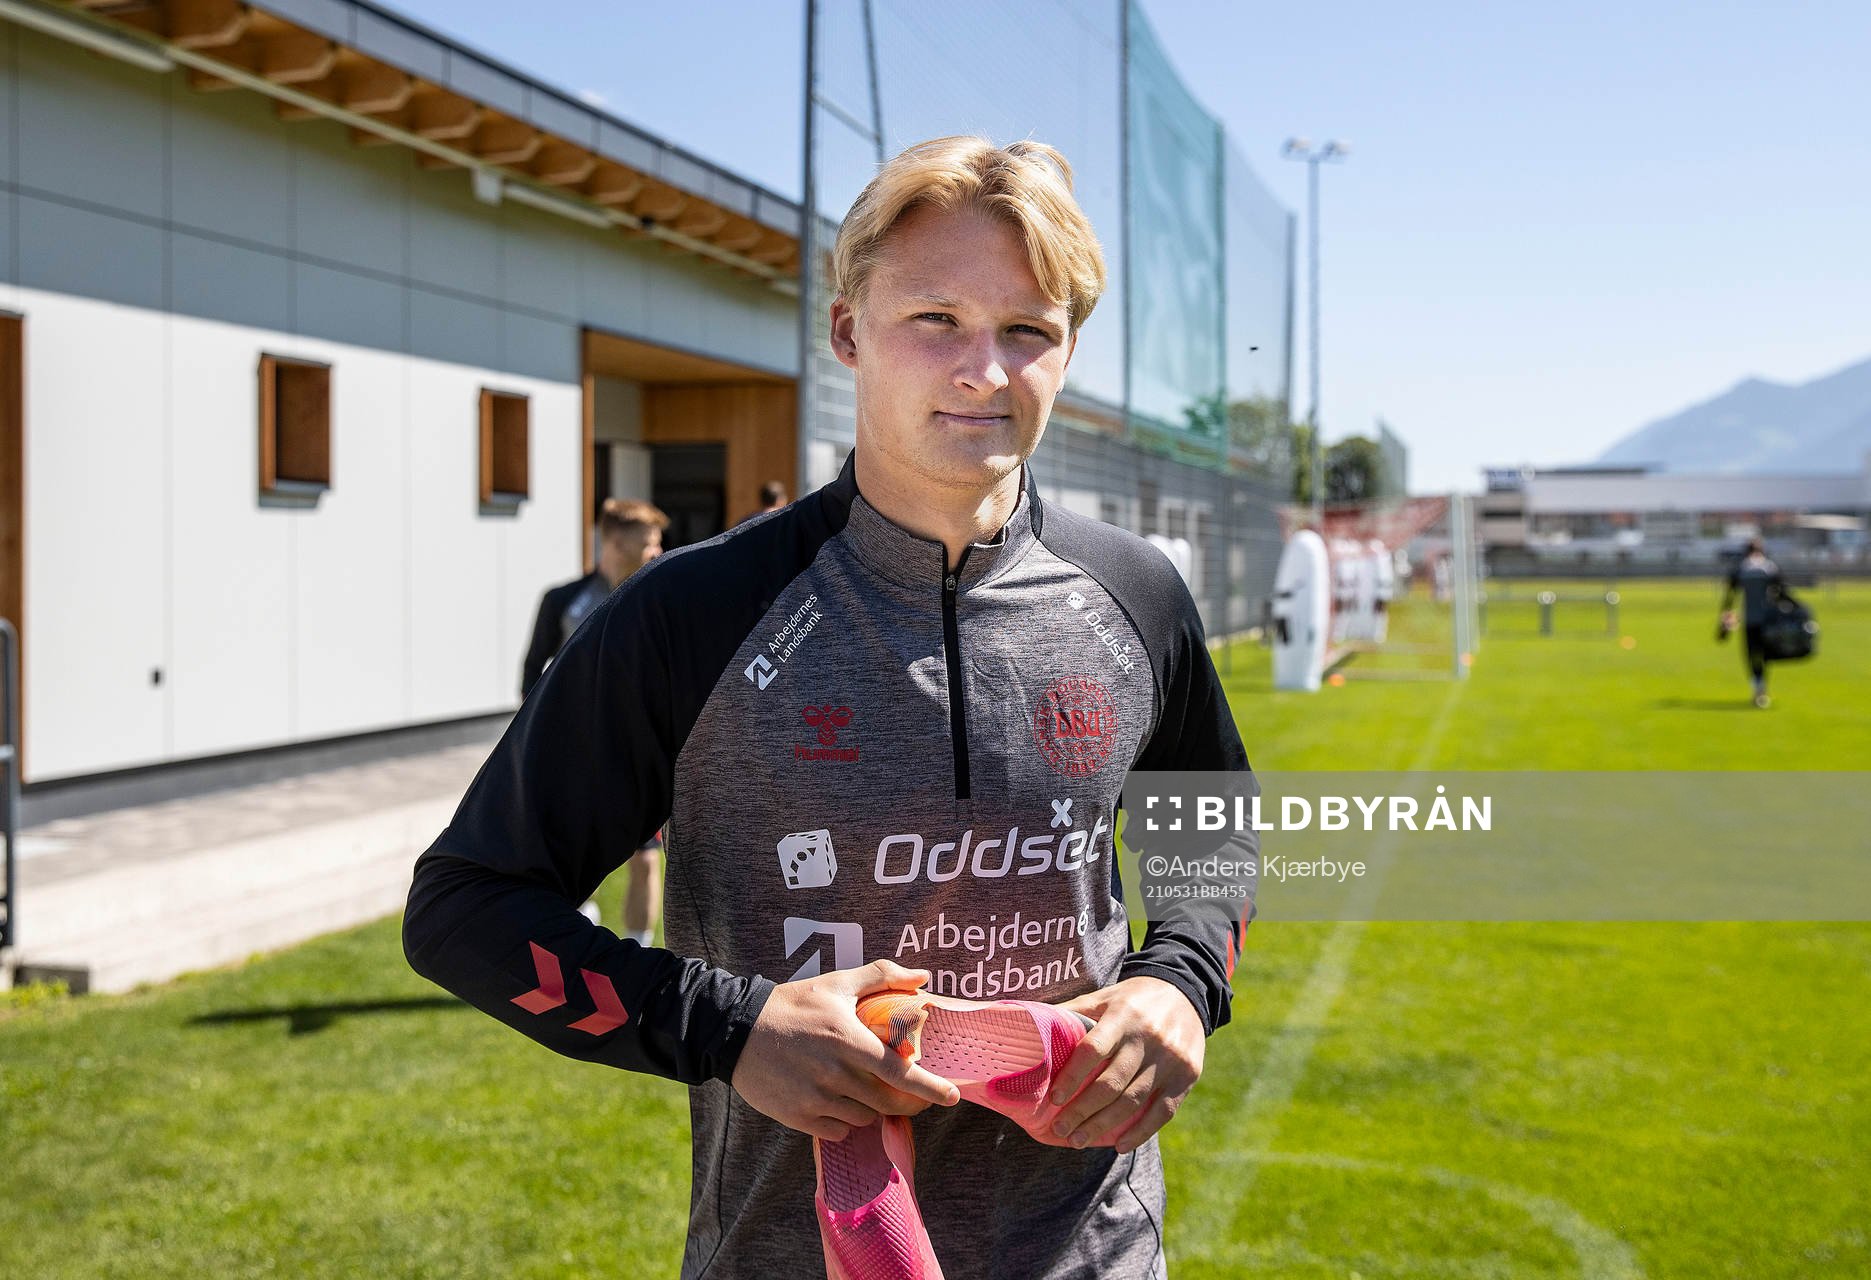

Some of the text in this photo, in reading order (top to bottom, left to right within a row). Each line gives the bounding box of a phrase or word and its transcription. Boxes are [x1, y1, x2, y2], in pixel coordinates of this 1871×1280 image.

[768, 594, 818, 653] Arbejdernes
[777, 610, 823, 662] Landsbank
[1085, 611, 1135, 675] Oddset
[1053, 709, 1101, 738] DBU
[794, 743, 860, 762] hummel
[873, 815, 1108, 885] Oddset
[922, 947, 1082, 998] ndsbank
